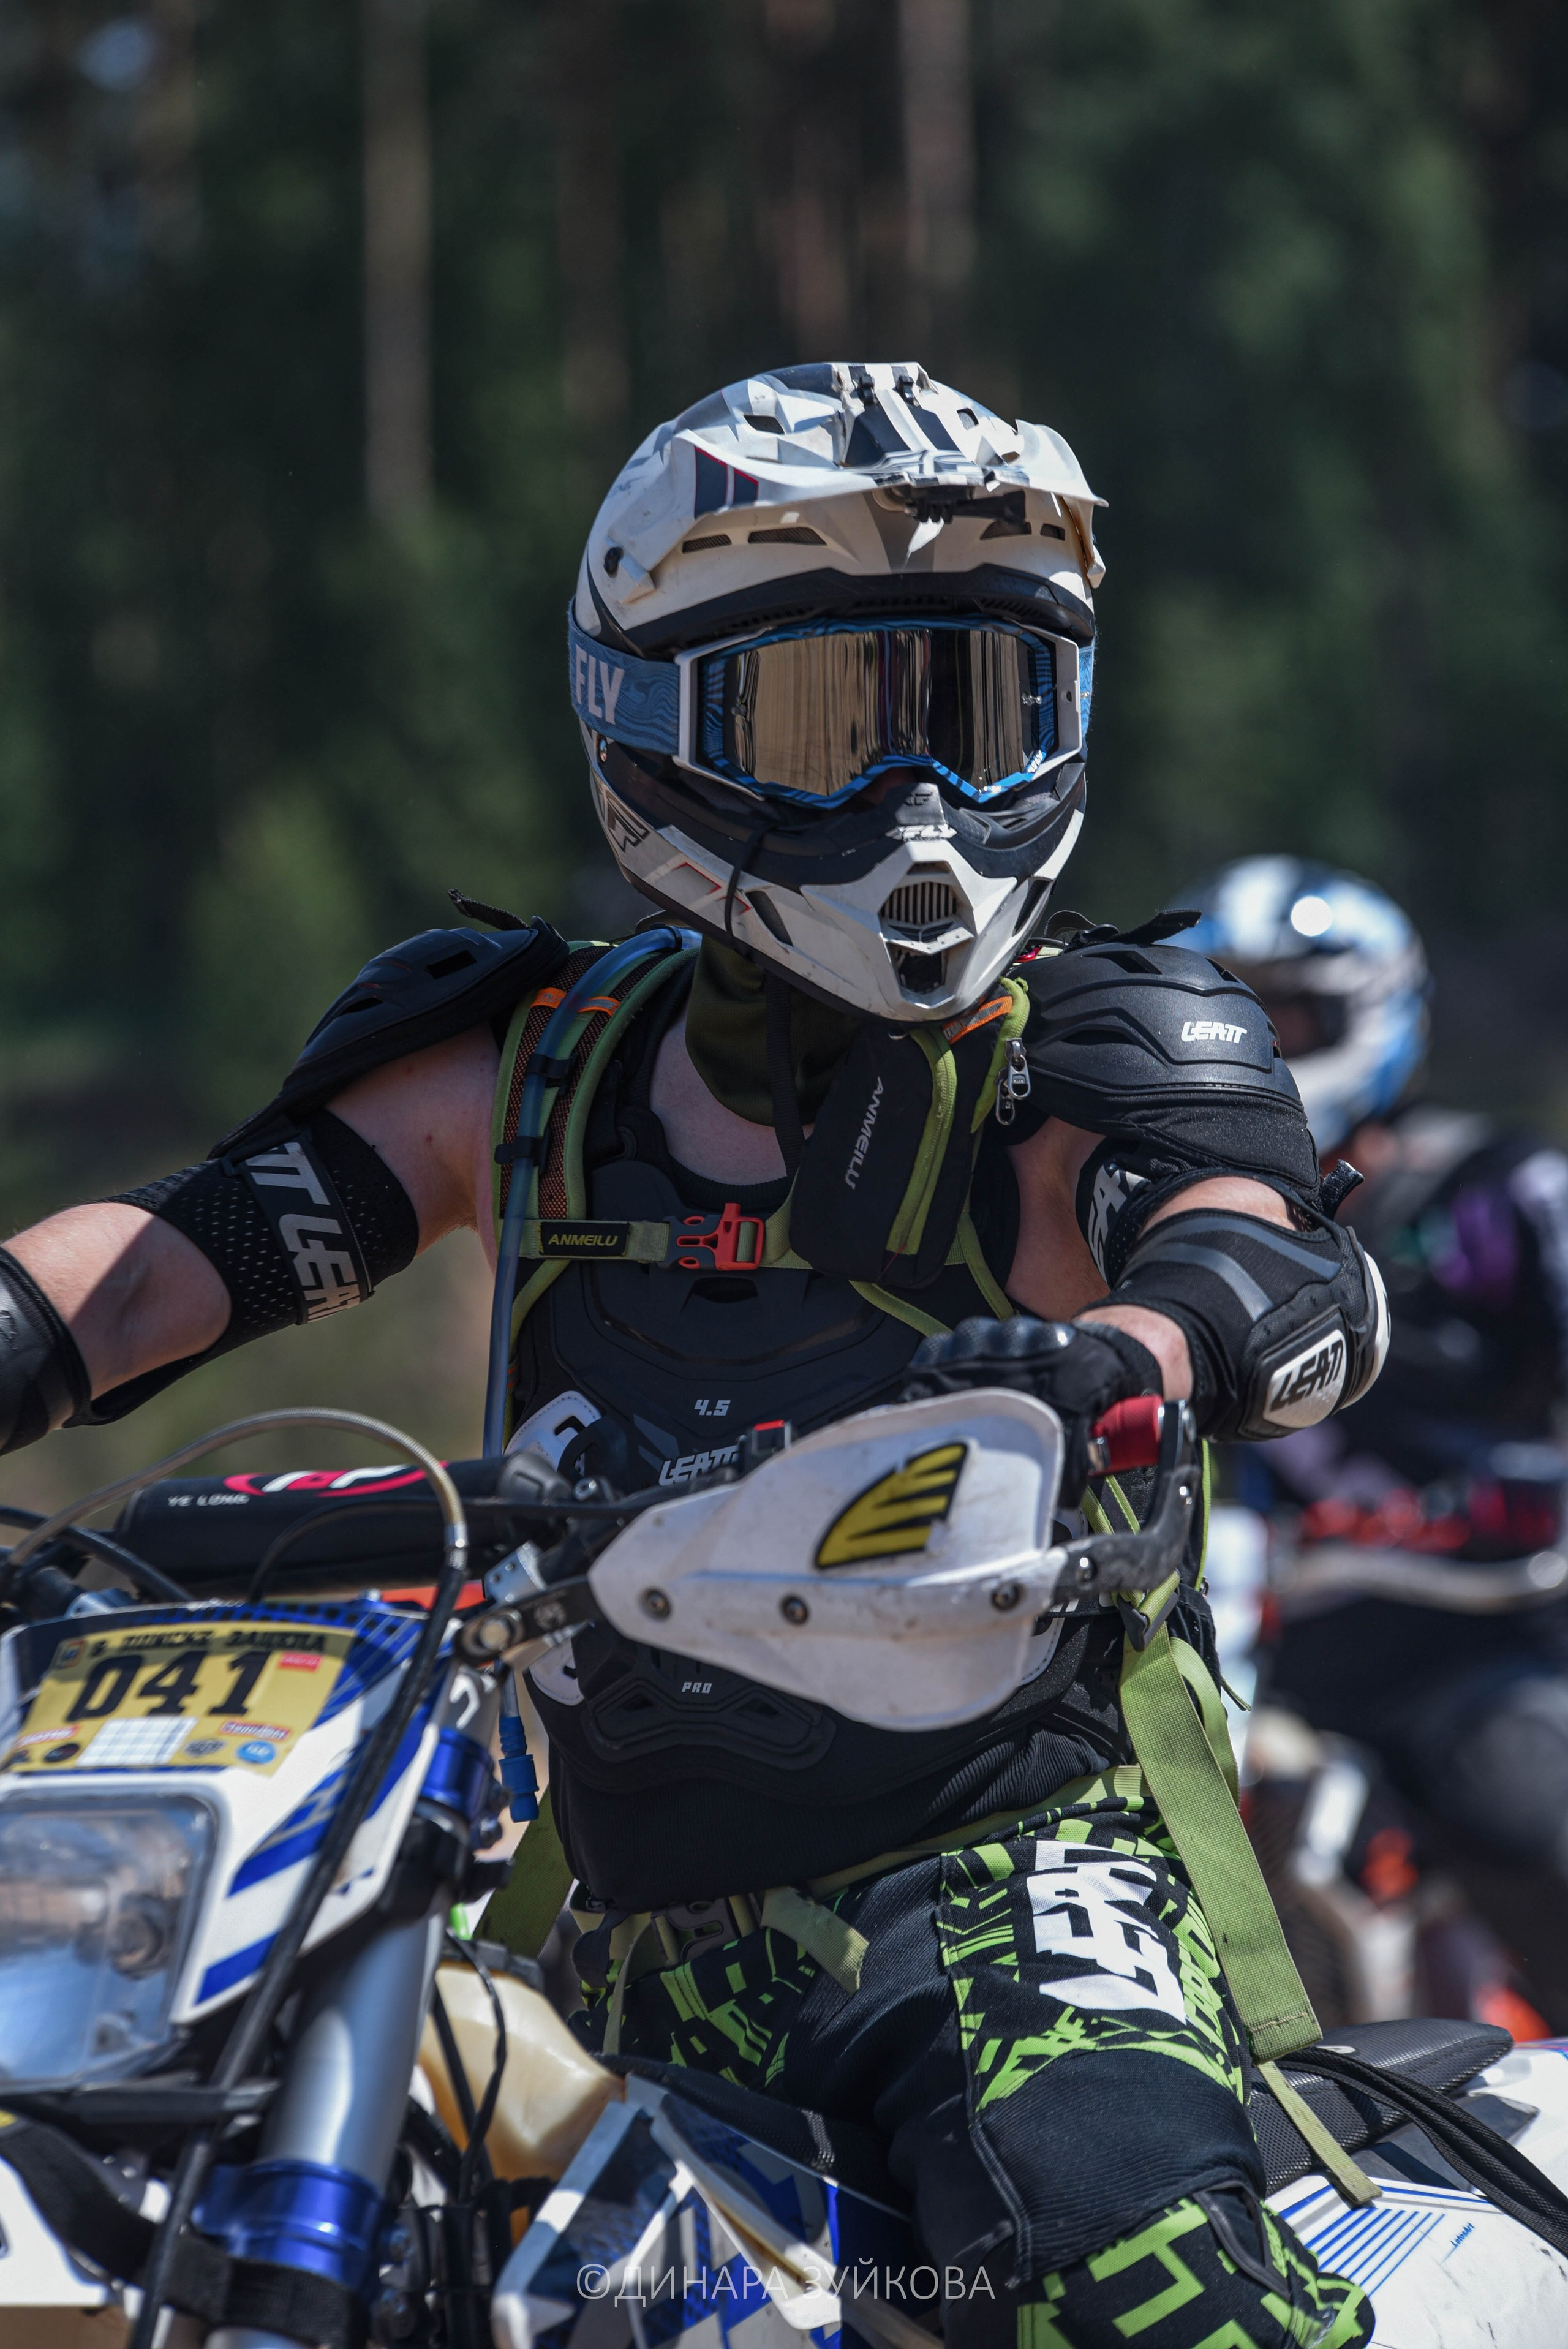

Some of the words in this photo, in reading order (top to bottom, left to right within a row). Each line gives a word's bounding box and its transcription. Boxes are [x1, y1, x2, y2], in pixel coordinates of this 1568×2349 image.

[575, 644, 625, 725] FLY
[1181, 1021, 1248, 1043] LEATT
[845, 1076, 884, 1190] ANMEILU
[548, 1234, 618, 1247] ANMEILU
[694, 1399, 731, 1417] 4.5
[66, 1651, 275, 1723] 041
[681, 1681, 713, 1694] PRO
